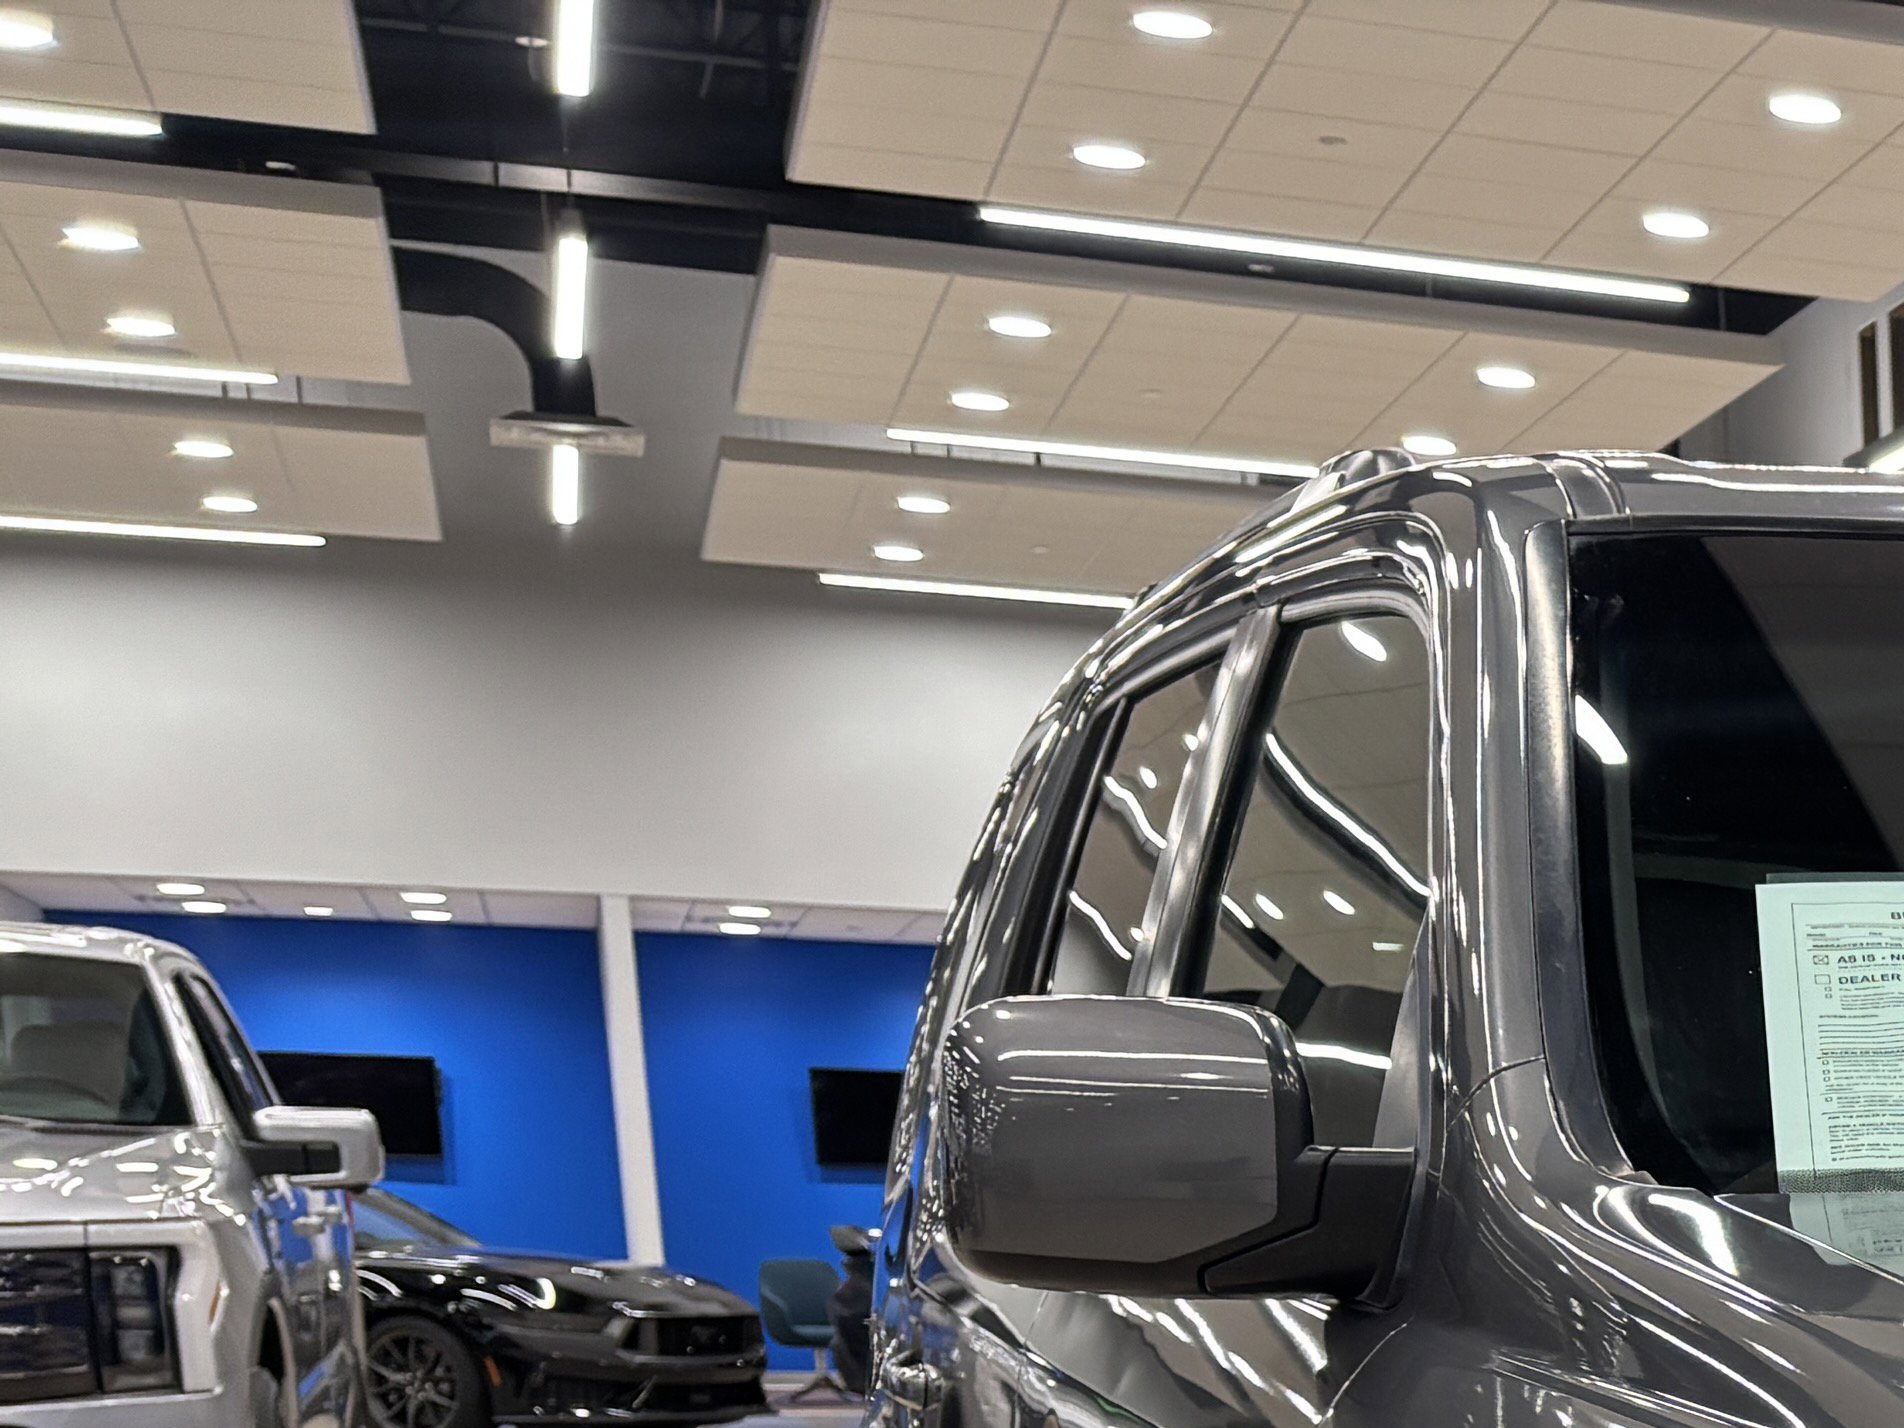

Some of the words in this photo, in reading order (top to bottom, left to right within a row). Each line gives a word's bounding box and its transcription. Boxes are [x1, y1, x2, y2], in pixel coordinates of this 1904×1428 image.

[1837, 954, 1858, 964] AS
[1862, 953, 1876, 963] IS
[1838, 973, 1901, 985] DEALER
